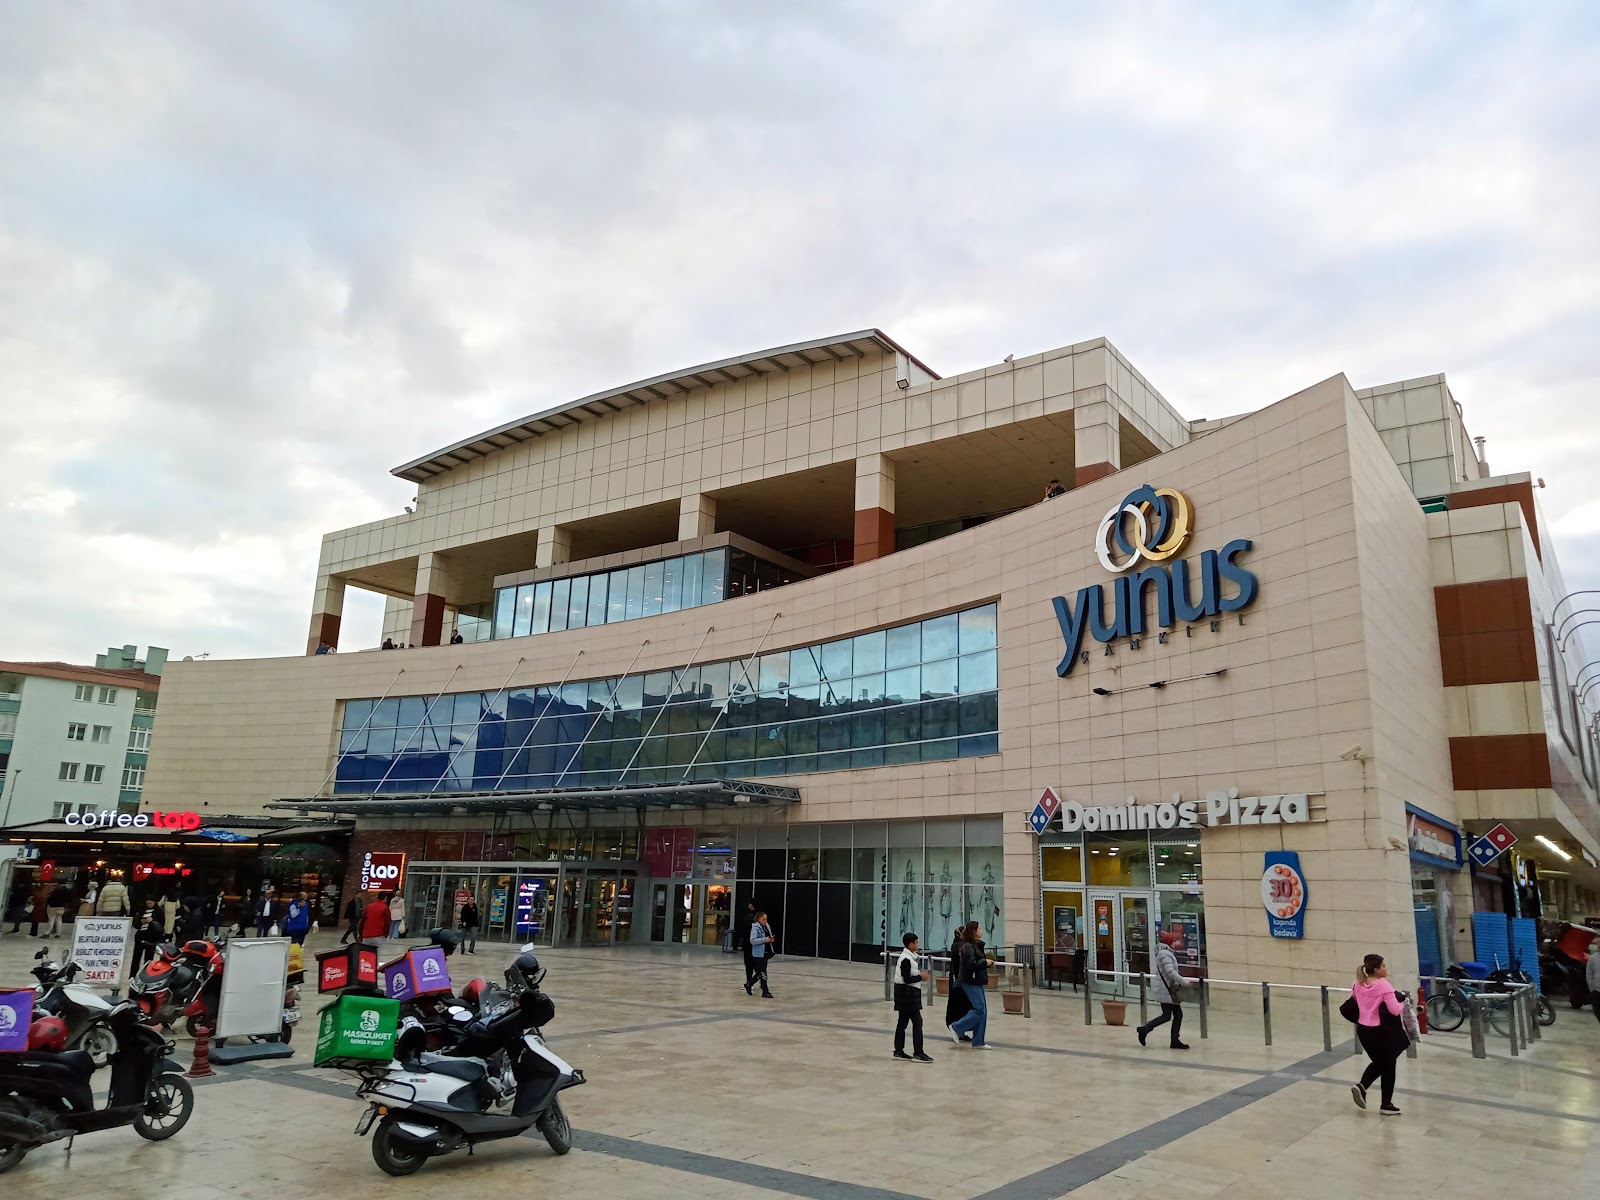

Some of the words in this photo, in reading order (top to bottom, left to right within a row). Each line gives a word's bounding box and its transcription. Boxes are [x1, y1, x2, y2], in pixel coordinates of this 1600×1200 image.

[1052, 539, 1259, 677] yunus
[1061, 792, 1199, 832] Domino's
[1206, 787, 1310, 828] Pizza
[65, 810, 149, 828] coffee
[153, 810, 202, 830] lab
[361, 852, 372, 890] coffee
[370, 864, 399, 879] lab
[1269, 879, 1292, 897] 30
[86, 971, 115, 980] SAKTIR
